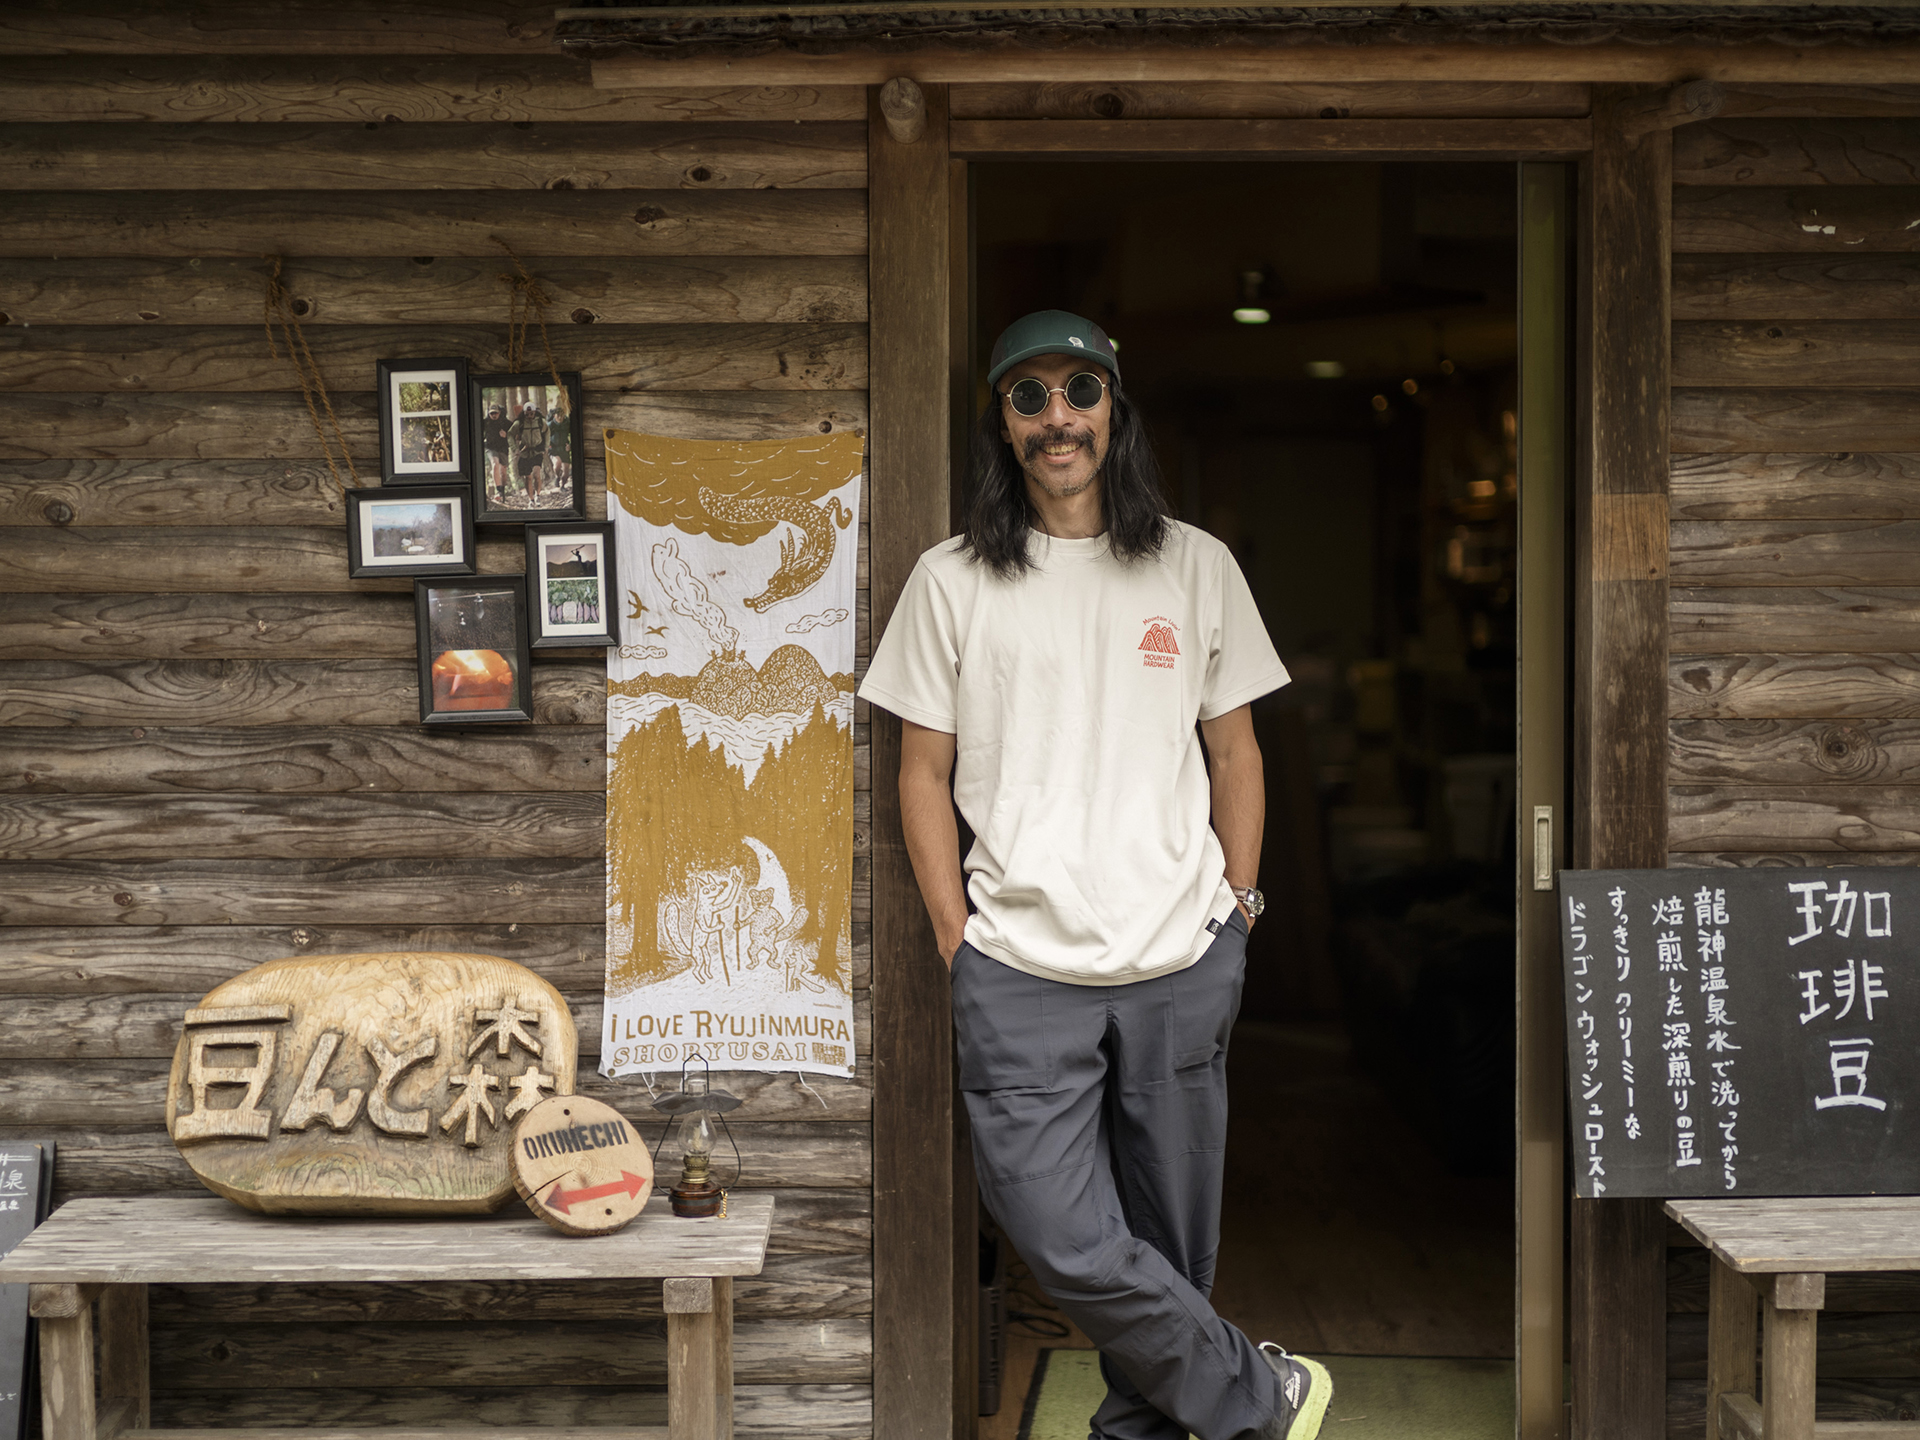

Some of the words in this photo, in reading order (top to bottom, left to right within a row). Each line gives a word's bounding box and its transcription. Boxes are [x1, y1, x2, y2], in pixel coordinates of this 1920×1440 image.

[1143, 660, 1175, 669] HARDWEAR
[1144, 654, 1175, 662] MOUNTAIN
[1788, 880, 1891, 1110] 珈琲豆
[625, 1014, 684, 1040] LOVE
[1652, 896, 1701, 1167] 焙煎した深煎りの豆
[1694, 886, 1741, 1189] 龍神温泉水で洗ってから
[612, 1041, 808, 1068] SHORYUSAI
[522, 1120, 629, 1160] OKUHECHI
[1292, 1371, 1301, 1409] montrail
